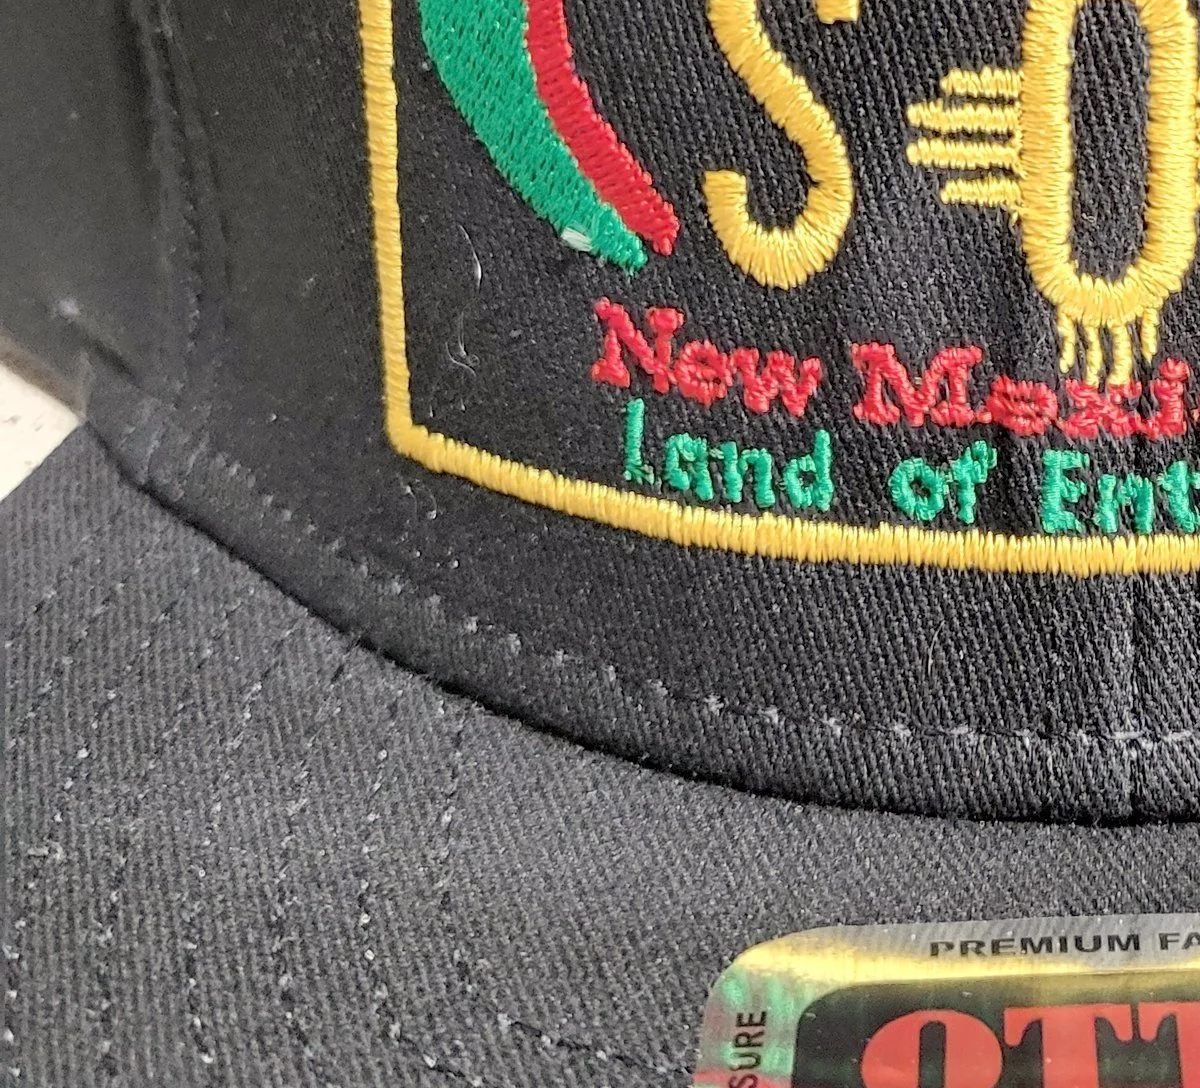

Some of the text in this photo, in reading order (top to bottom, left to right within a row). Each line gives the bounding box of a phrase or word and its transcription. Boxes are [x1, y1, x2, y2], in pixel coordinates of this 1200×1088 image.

[591, 296, 822, 418] New
[623, 397, 835, 512] Land
[886, 439, 998, 525] of
[929, 932, 1142, 958] PREMIUM
